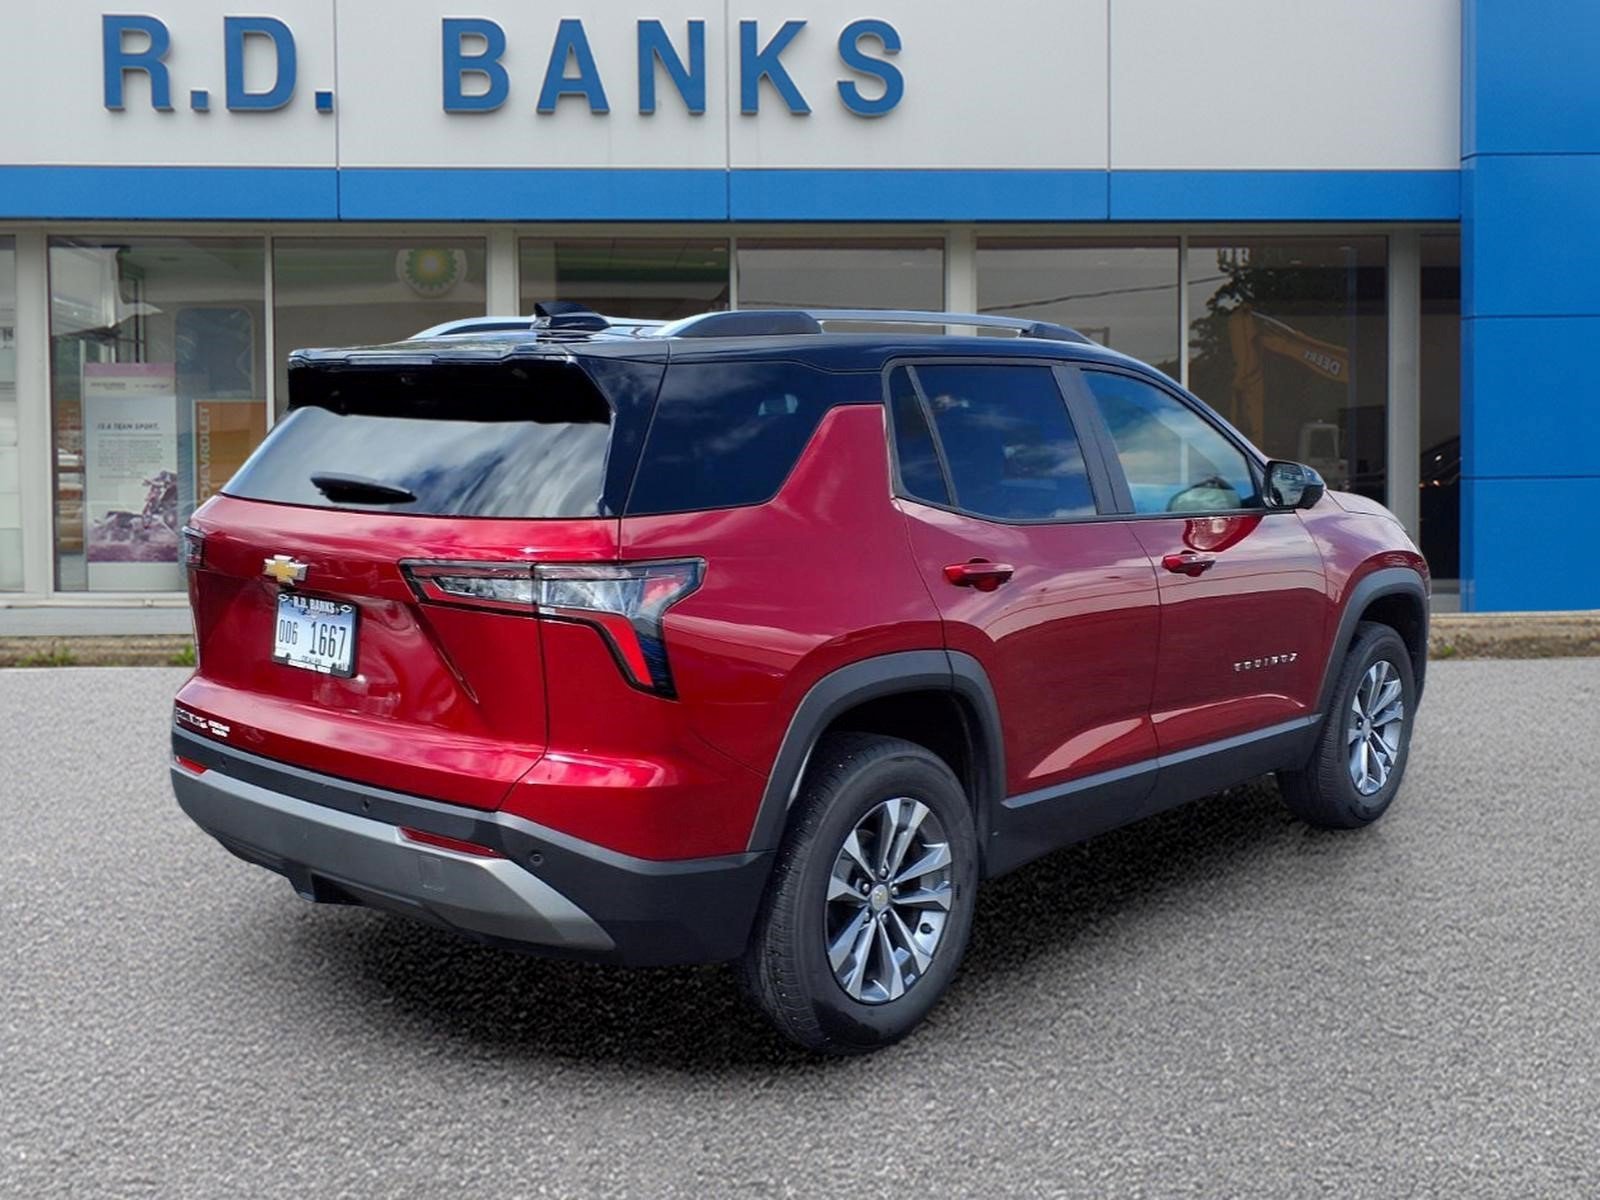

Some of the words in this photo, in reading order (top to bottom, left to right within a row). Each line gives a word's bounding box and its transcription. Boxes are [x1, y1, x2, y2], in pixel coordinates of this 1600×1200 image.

[102, 14, 334, 112] R.D.
[441, 17, 905, 117] BANKS
[309, 621, 346, 661] 1667
